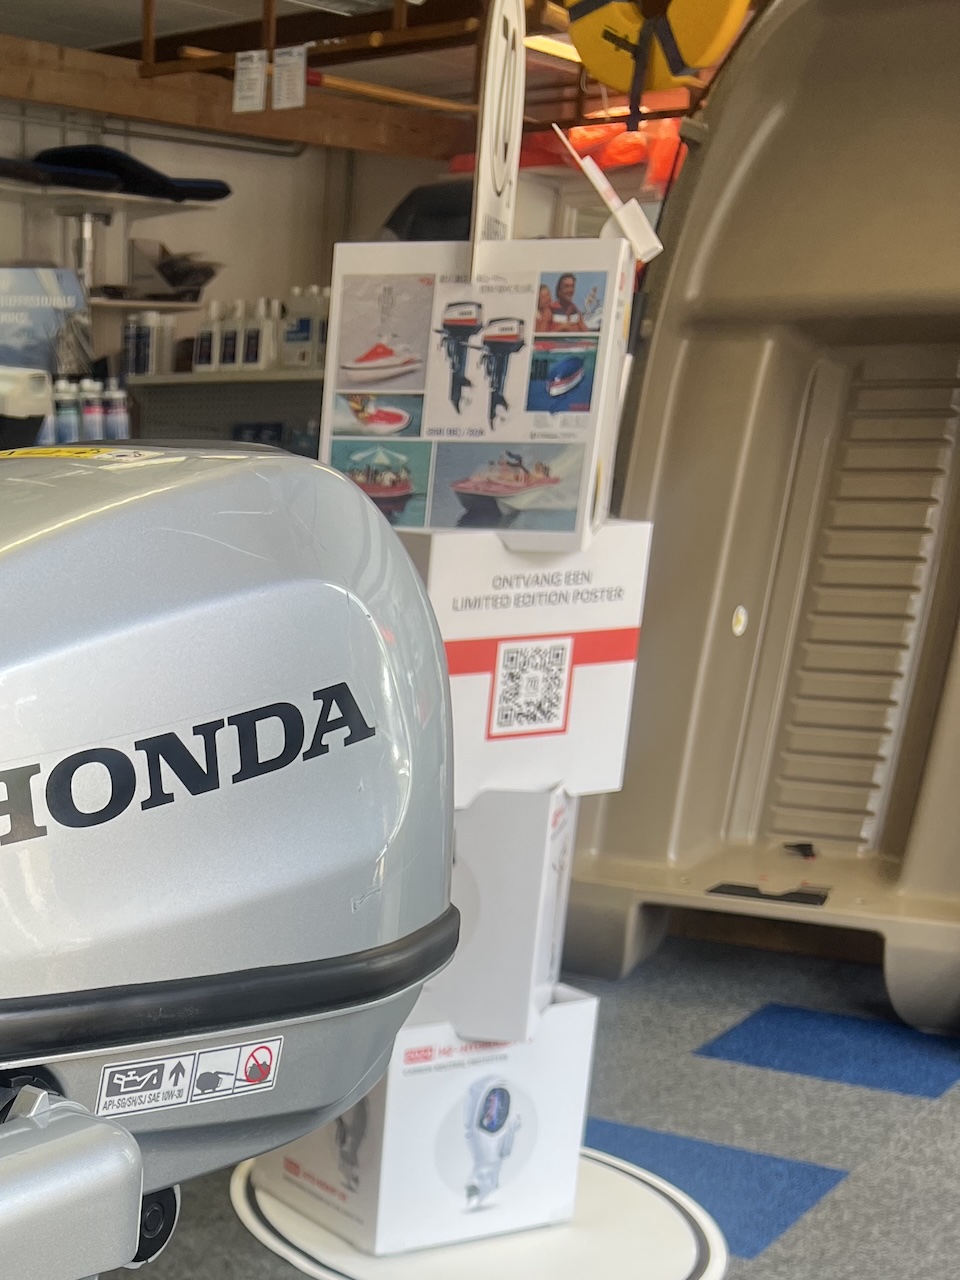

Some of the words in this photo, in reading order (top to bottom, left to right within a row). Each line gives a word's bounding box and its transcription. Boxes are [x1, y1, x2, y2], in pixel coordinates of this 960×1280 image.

[492, 572, 563, 590] ONTVANG
[564, 570, 593, 586] EEN
[452, 593, 512, 612] LIMITED
[513, 590, 570, 609] EDITION
[572, 586, 625, 604] POSTER
[147, 1091, 160, 1104] SAE
[161, 1088, 184, 1101] 10W-30
